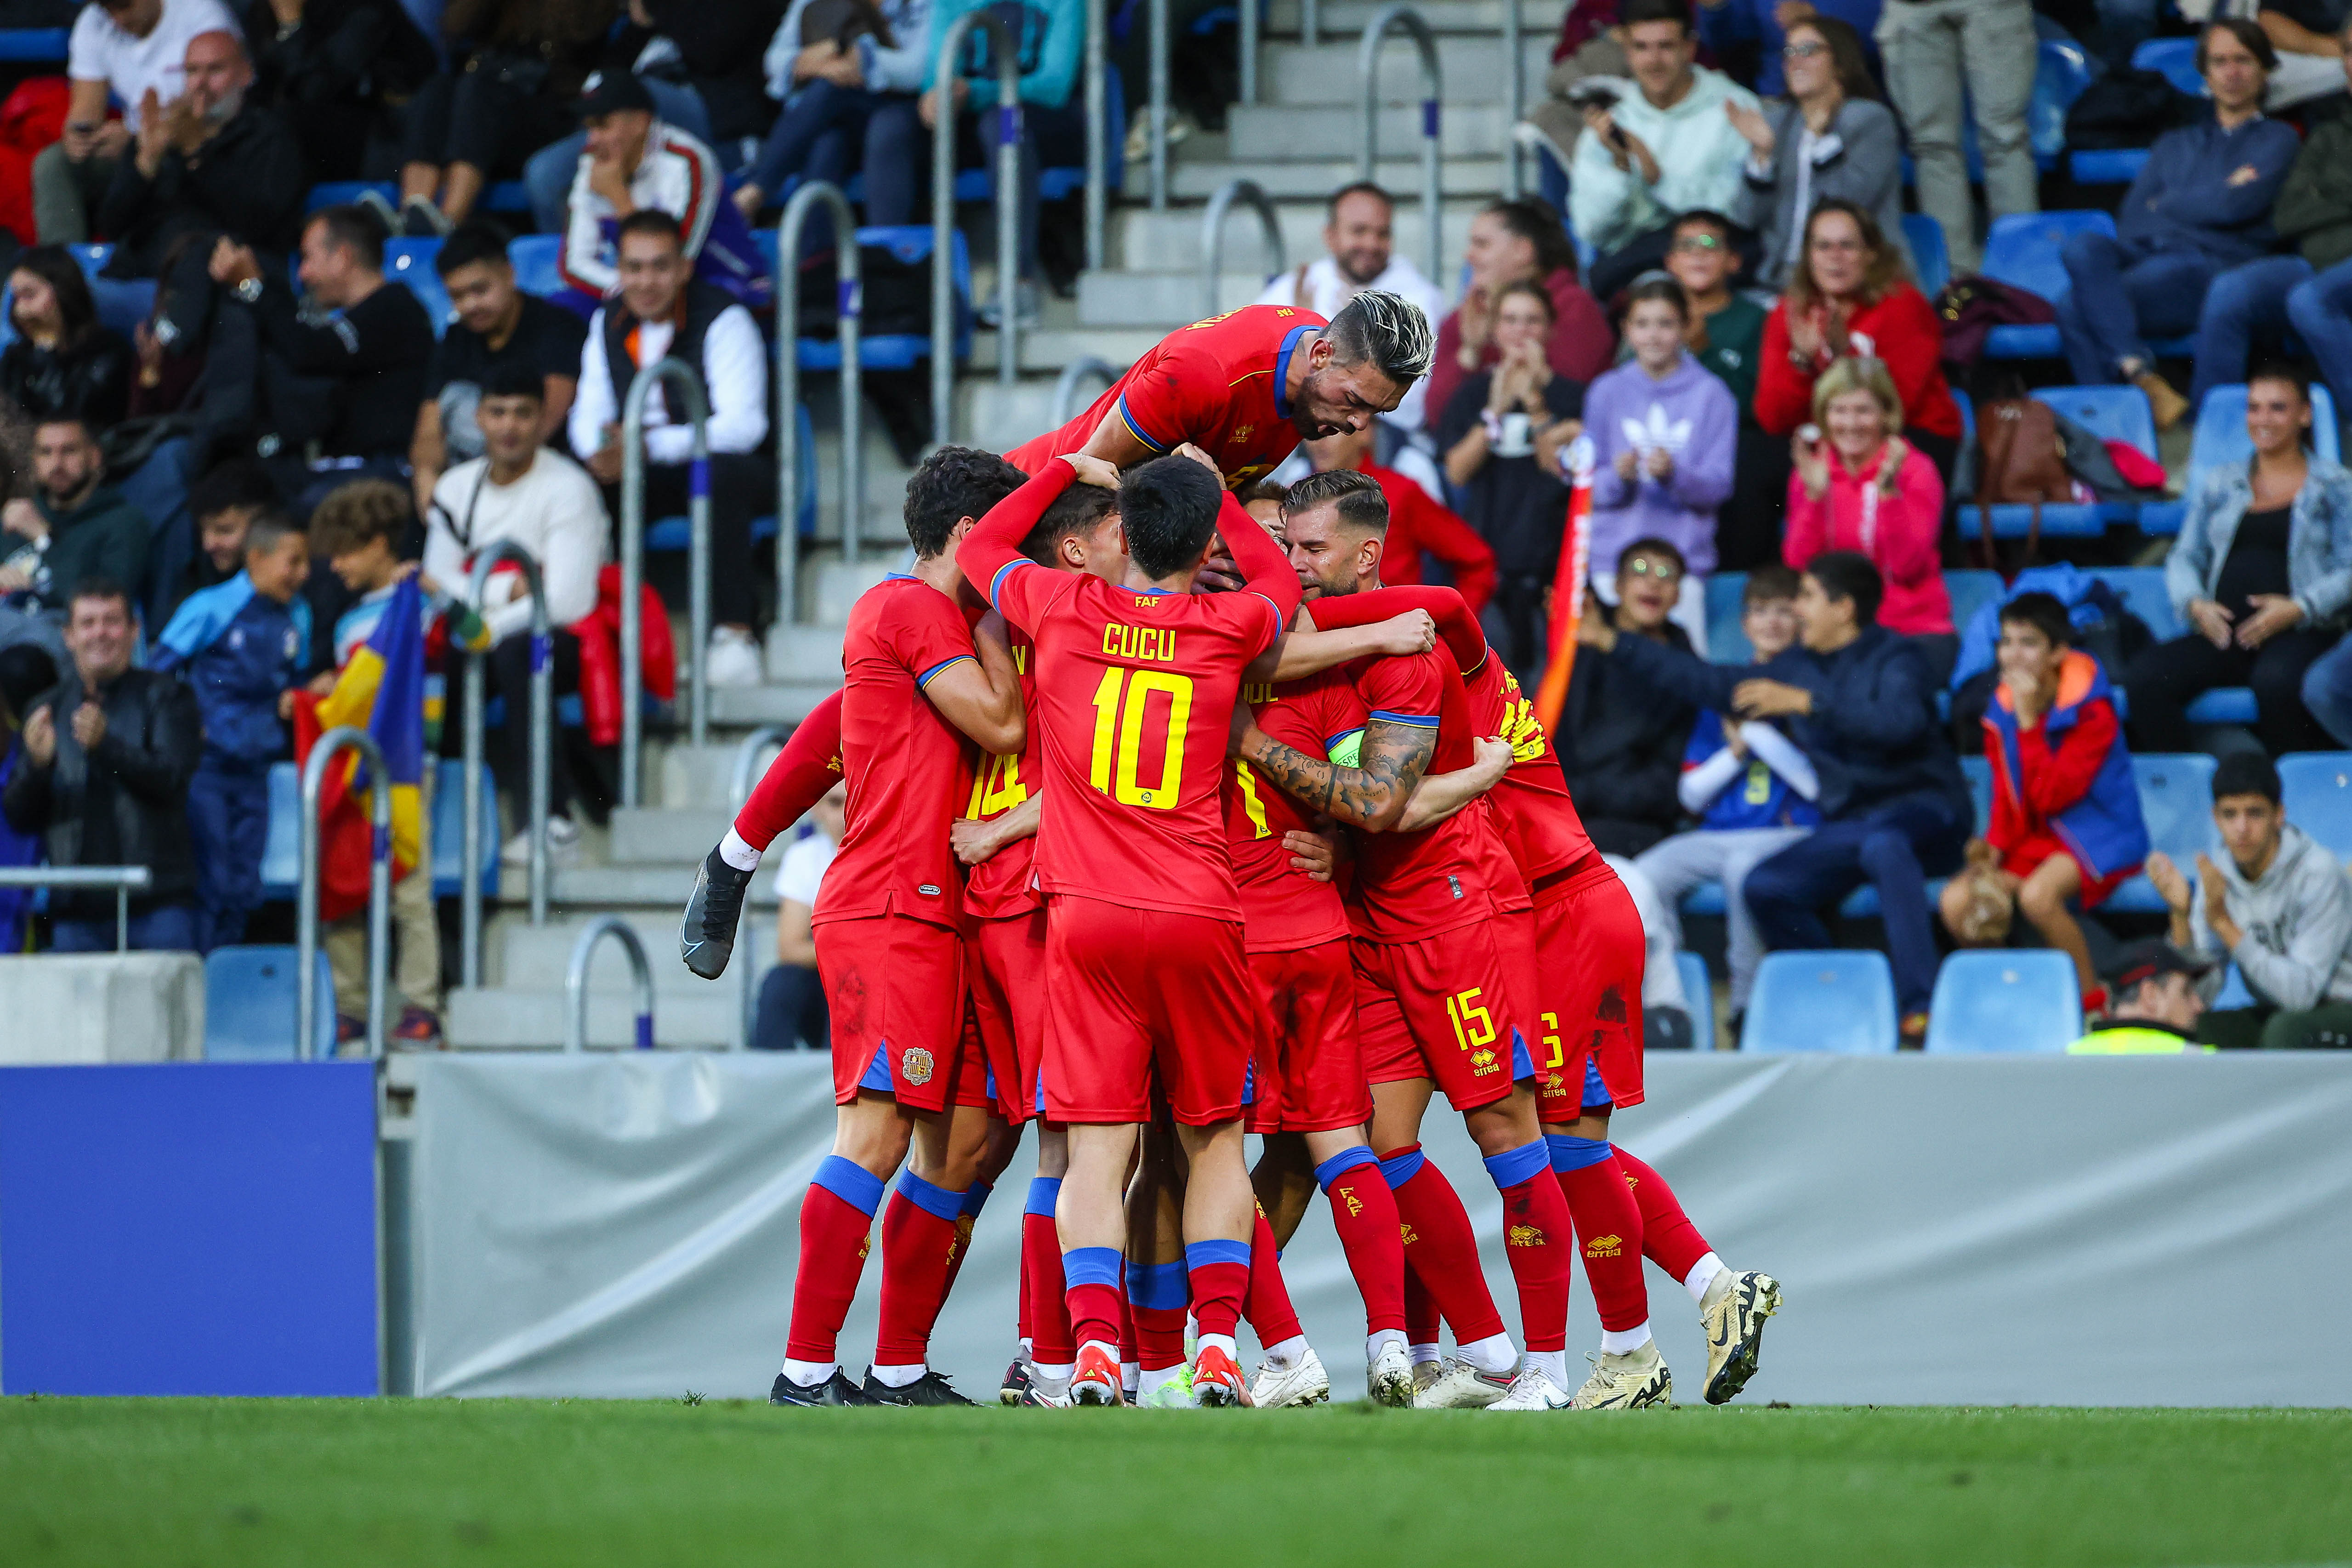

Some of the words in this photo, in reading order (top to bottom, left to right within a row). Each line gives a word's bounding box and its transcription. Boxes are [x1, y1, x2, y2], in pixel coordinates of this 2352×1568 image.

[1135, 596, 1161, 607] FAF
[1102, 623, 1176, 661] CUCU
[1090, 666, 1194, 810] 10
[1447, 987, 1496, 1051] 15
[1474, 1063, 1500, 1076] errea
[1542, 1088, 1567, 1097] errea
[1339, 1187, 1363, 1217] FAF
[1587, 1248, 1621, 1258] errea
